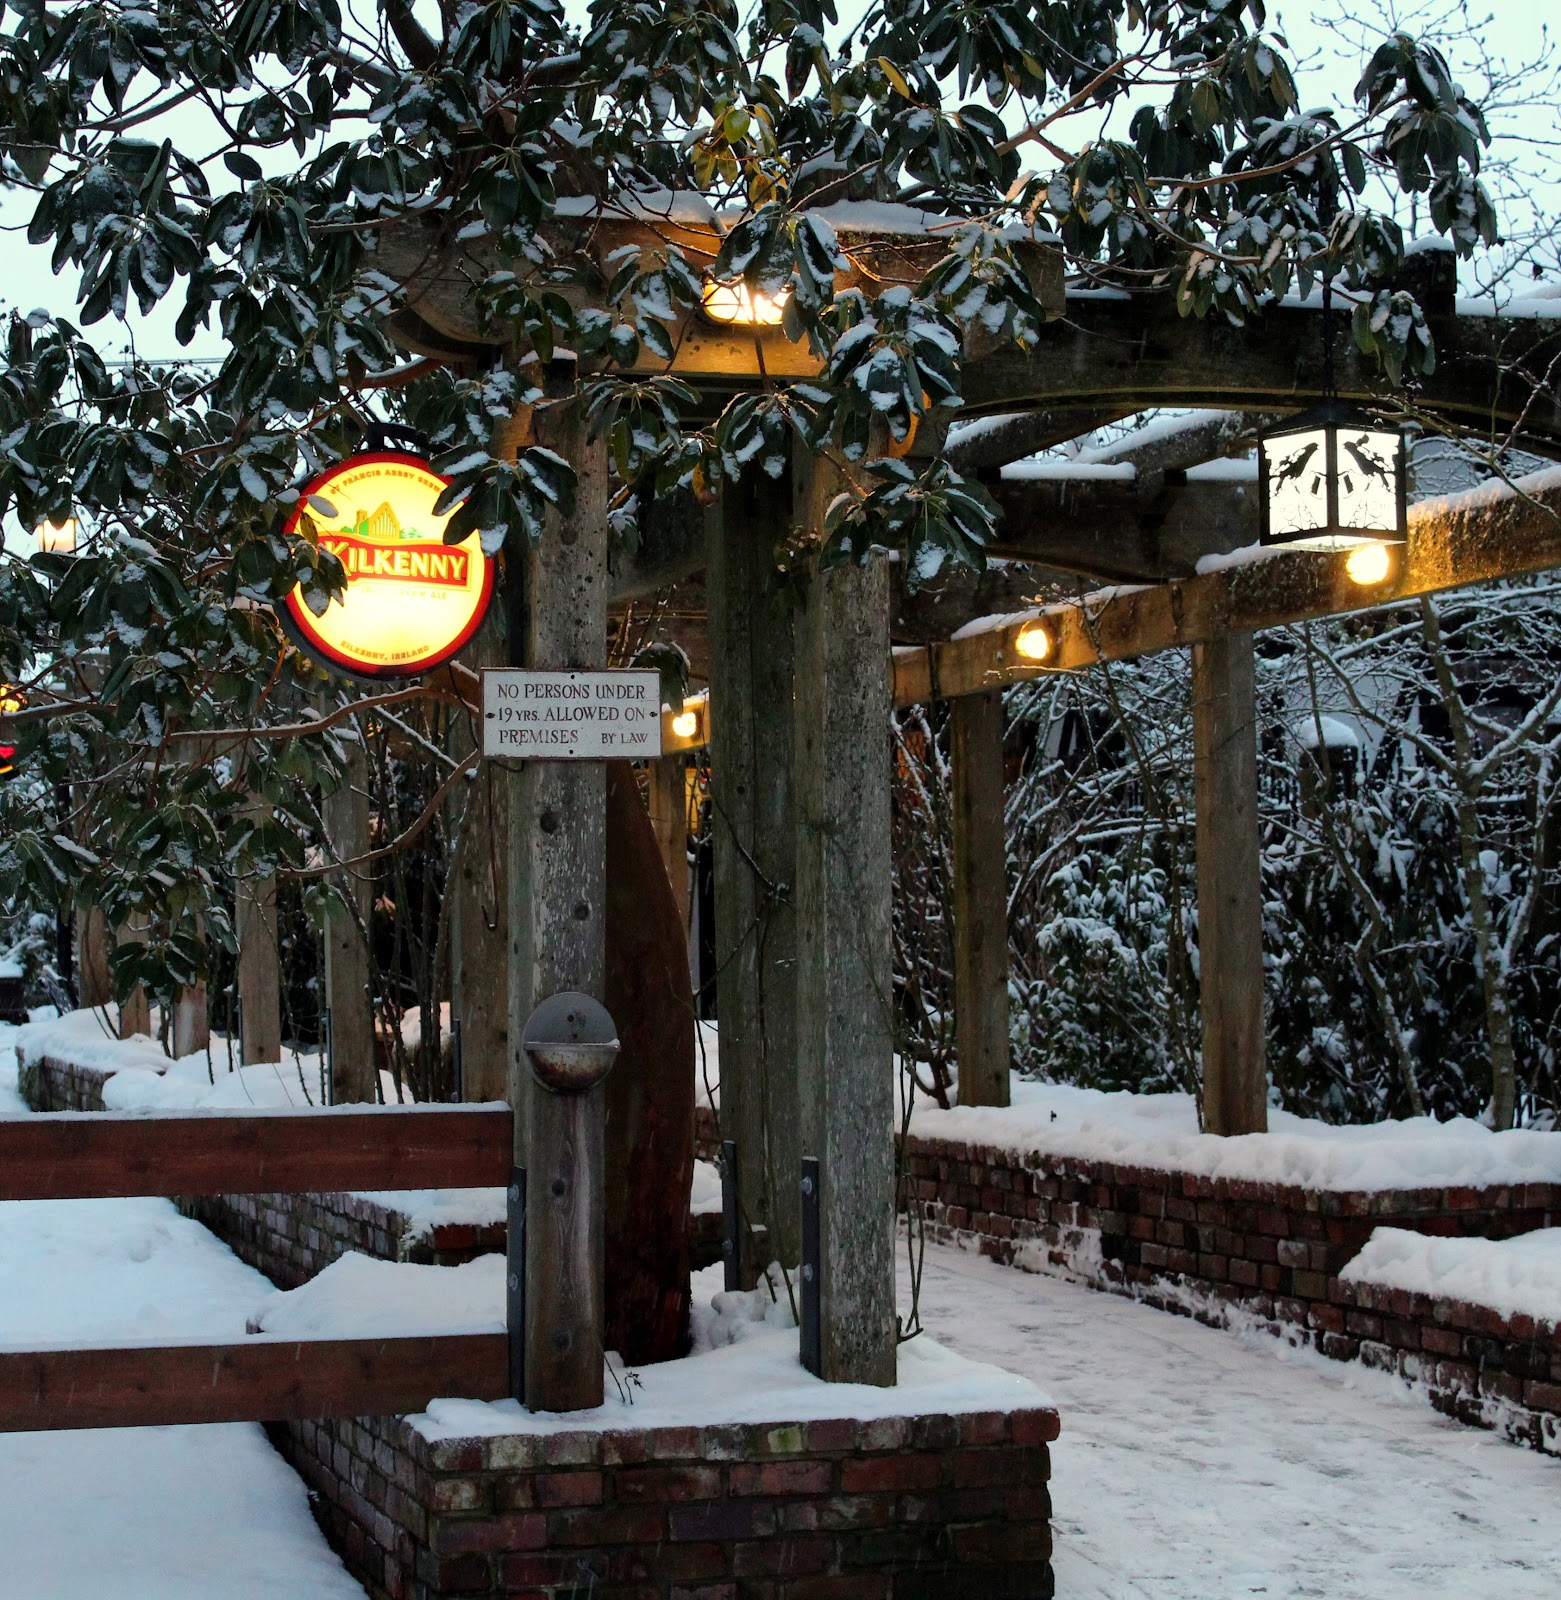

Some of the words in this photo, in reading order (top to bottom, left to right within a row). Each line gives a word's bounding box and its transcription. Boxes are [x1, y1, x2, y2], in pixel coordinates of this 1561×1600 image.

[323, 540, 466, 581] KILKENNY
[391, 644, 430, 660] IRELAND
[497, 683, 519, 699] NO
[524, 683, 590, 699] PERSONS
[595, 684, 645, 699] UNDER
[498, 707, 513, 723] 19
[515, 710, 540, 722] YRS.
[543, 706, 619, 722] ALLOWED
[624, 707, 645, 722] ON
[498, 729, 579, 744] PREMISES
[601, 732, 616, 744] BY
[621, 732, 648, 744] LAW
